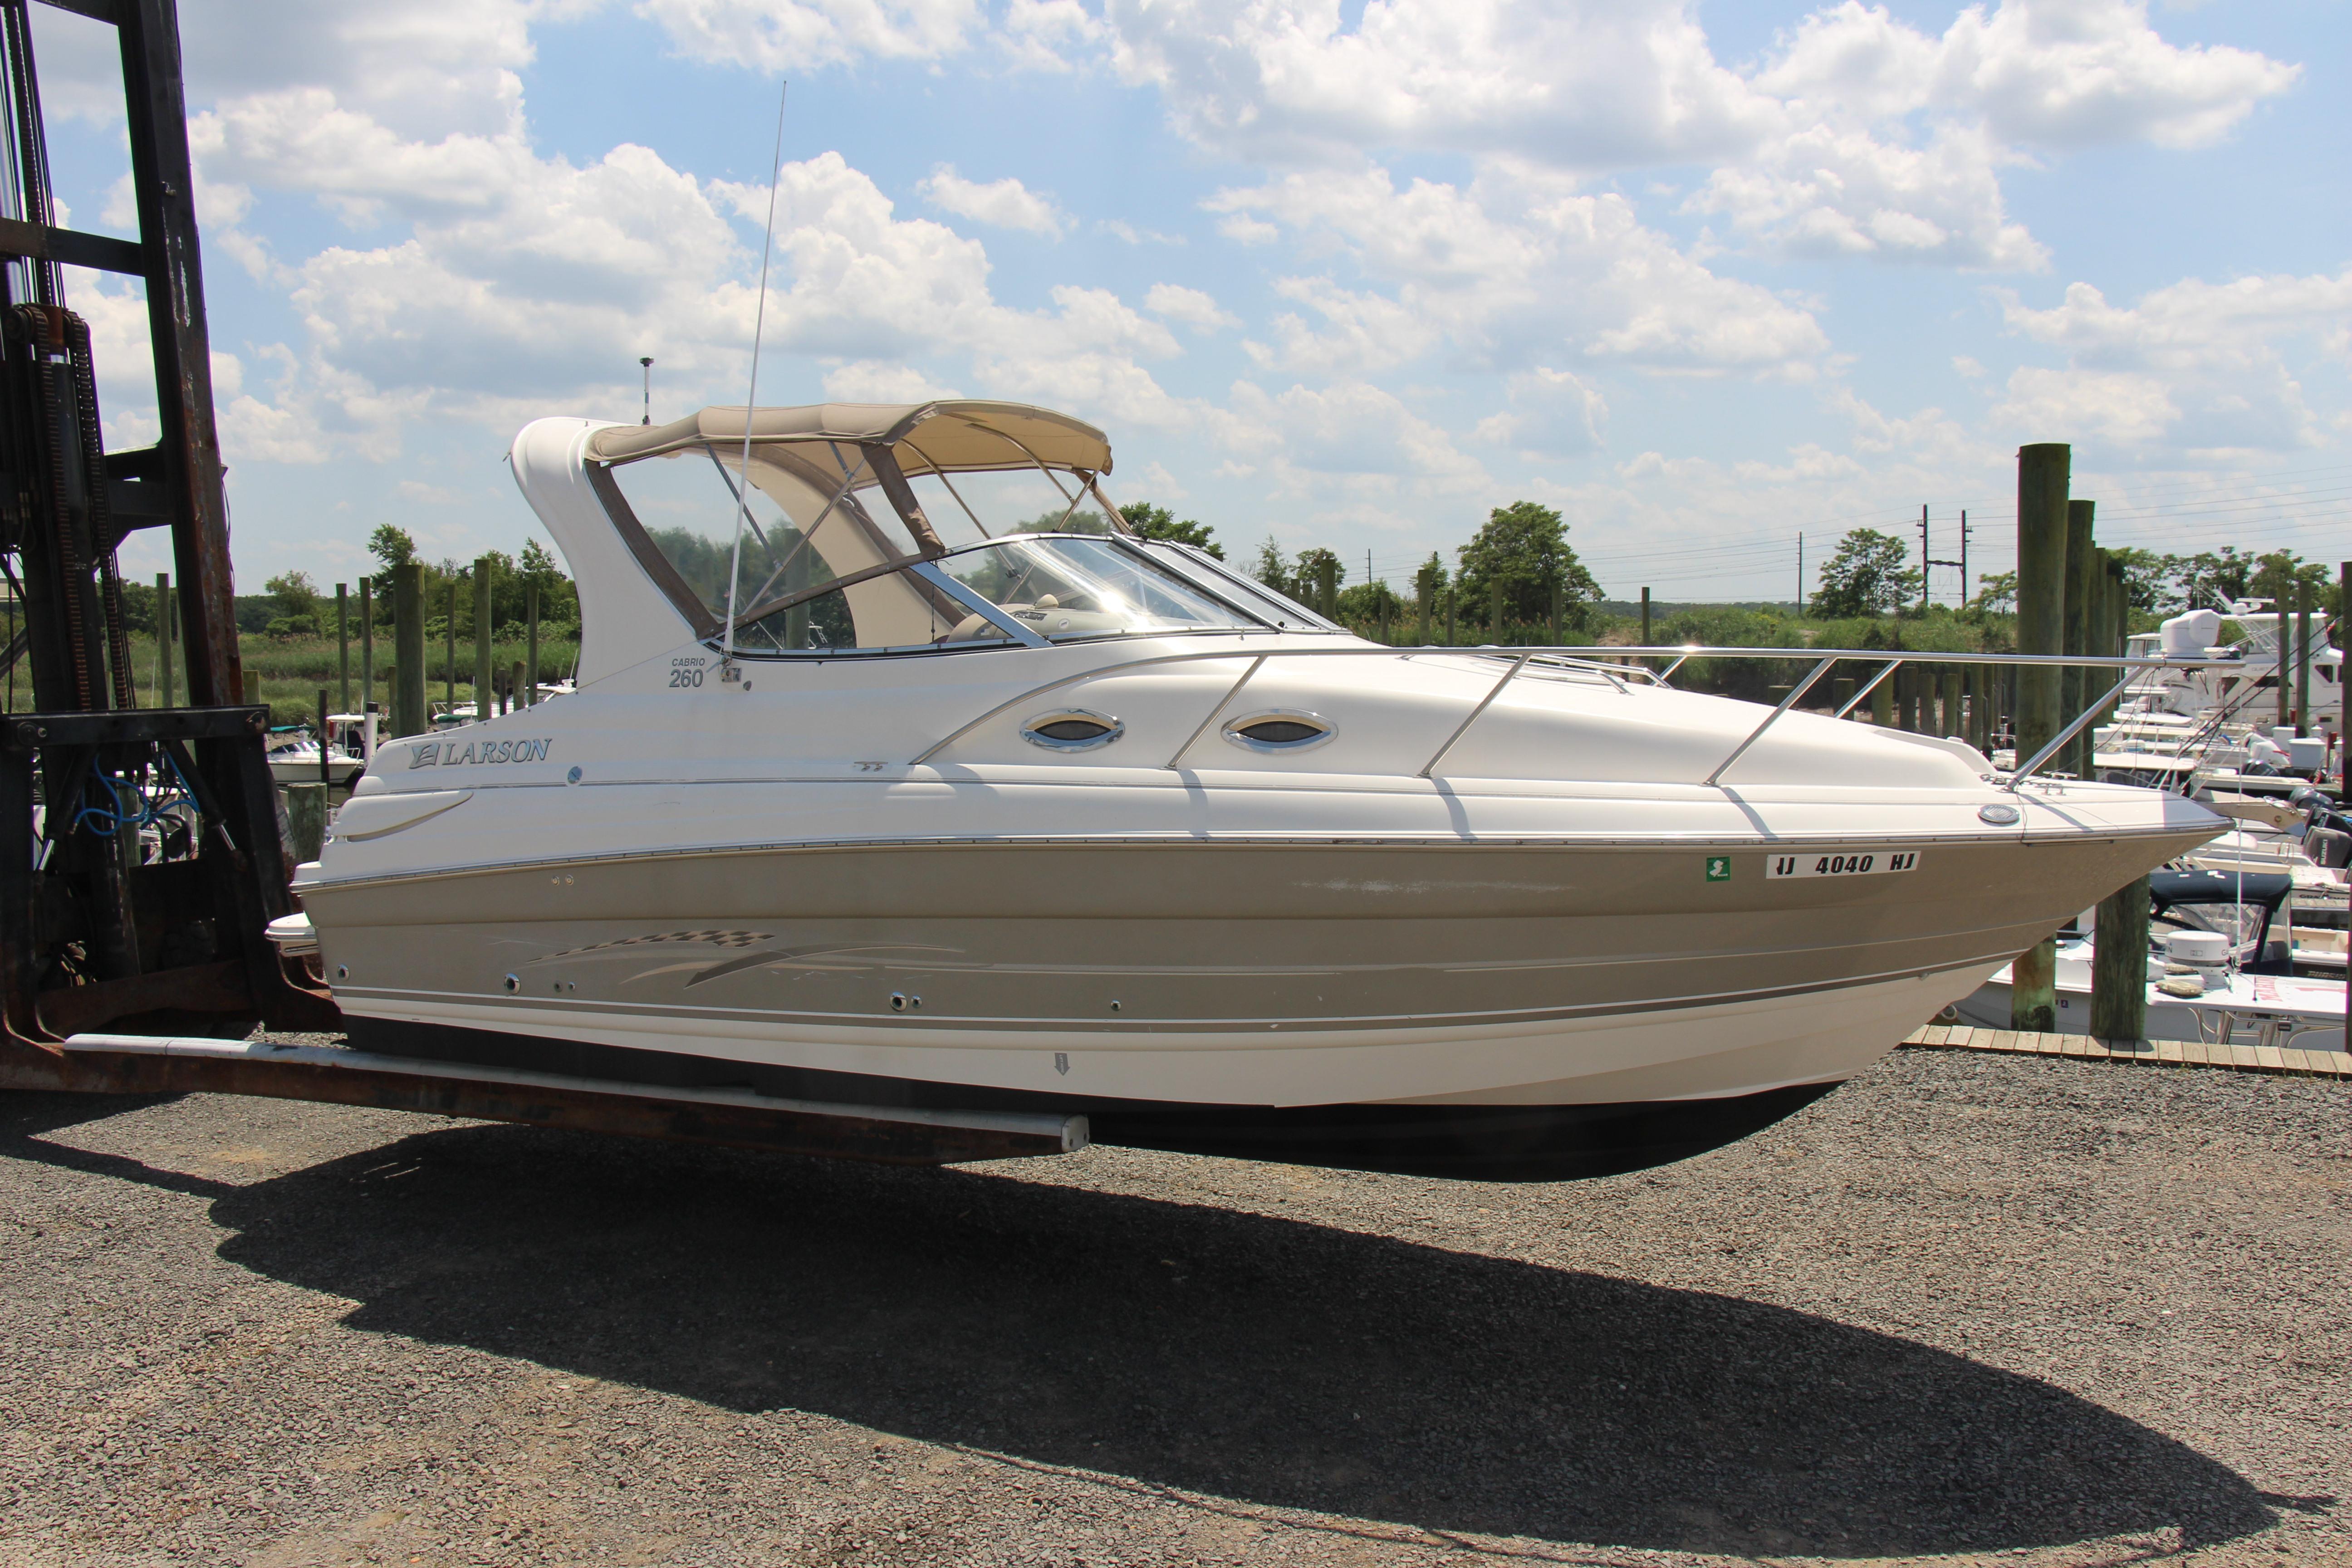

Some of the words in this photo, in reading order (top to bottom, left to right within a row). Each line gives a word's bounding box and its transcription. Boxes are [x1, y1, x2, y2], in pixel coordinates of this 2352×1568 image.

[671, 657, 705, 666] CABRIO
[669, 668, 703, 688] 260
[442, 738, 553, 766] LARSON
[1815, 855, 1873, 874] 4040
[1890, 853, 1915, 871] HJ
